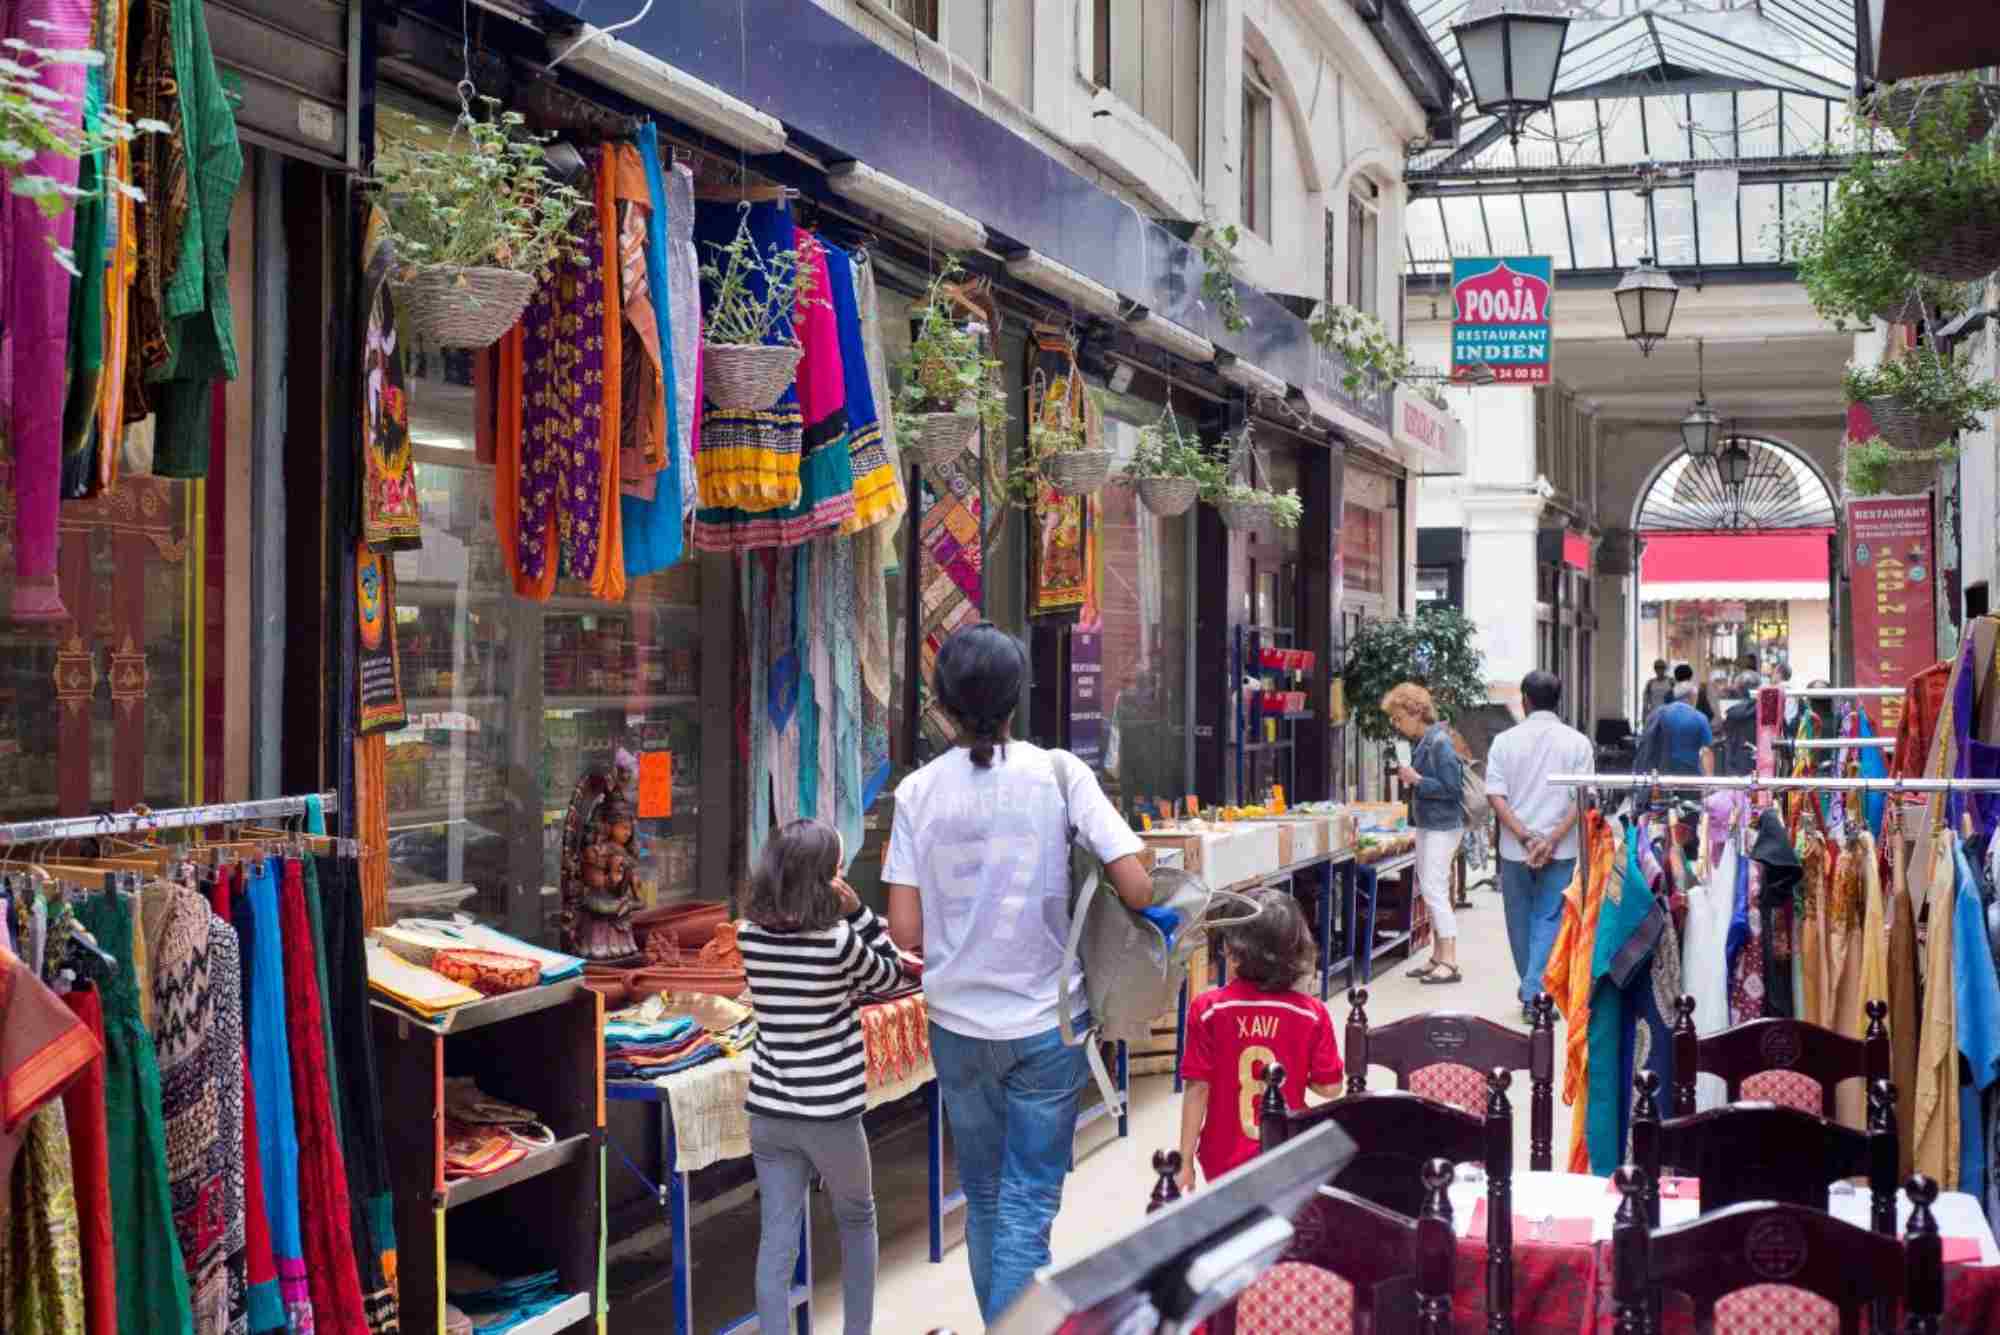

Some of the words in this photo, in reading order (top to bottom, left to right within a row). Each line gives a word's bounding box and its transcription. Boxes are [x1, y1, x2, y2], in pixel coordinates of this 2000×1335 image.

[1465, 278, 1538, 321] POOJA
[1457, 330, 1546, 341] RESTAURANT
[1456, 345, 1544, 360] INDIEN
[1855, 507, 1927, 520] RESTAURANT
[1237, 1015, 1280, 1039] XAVI
